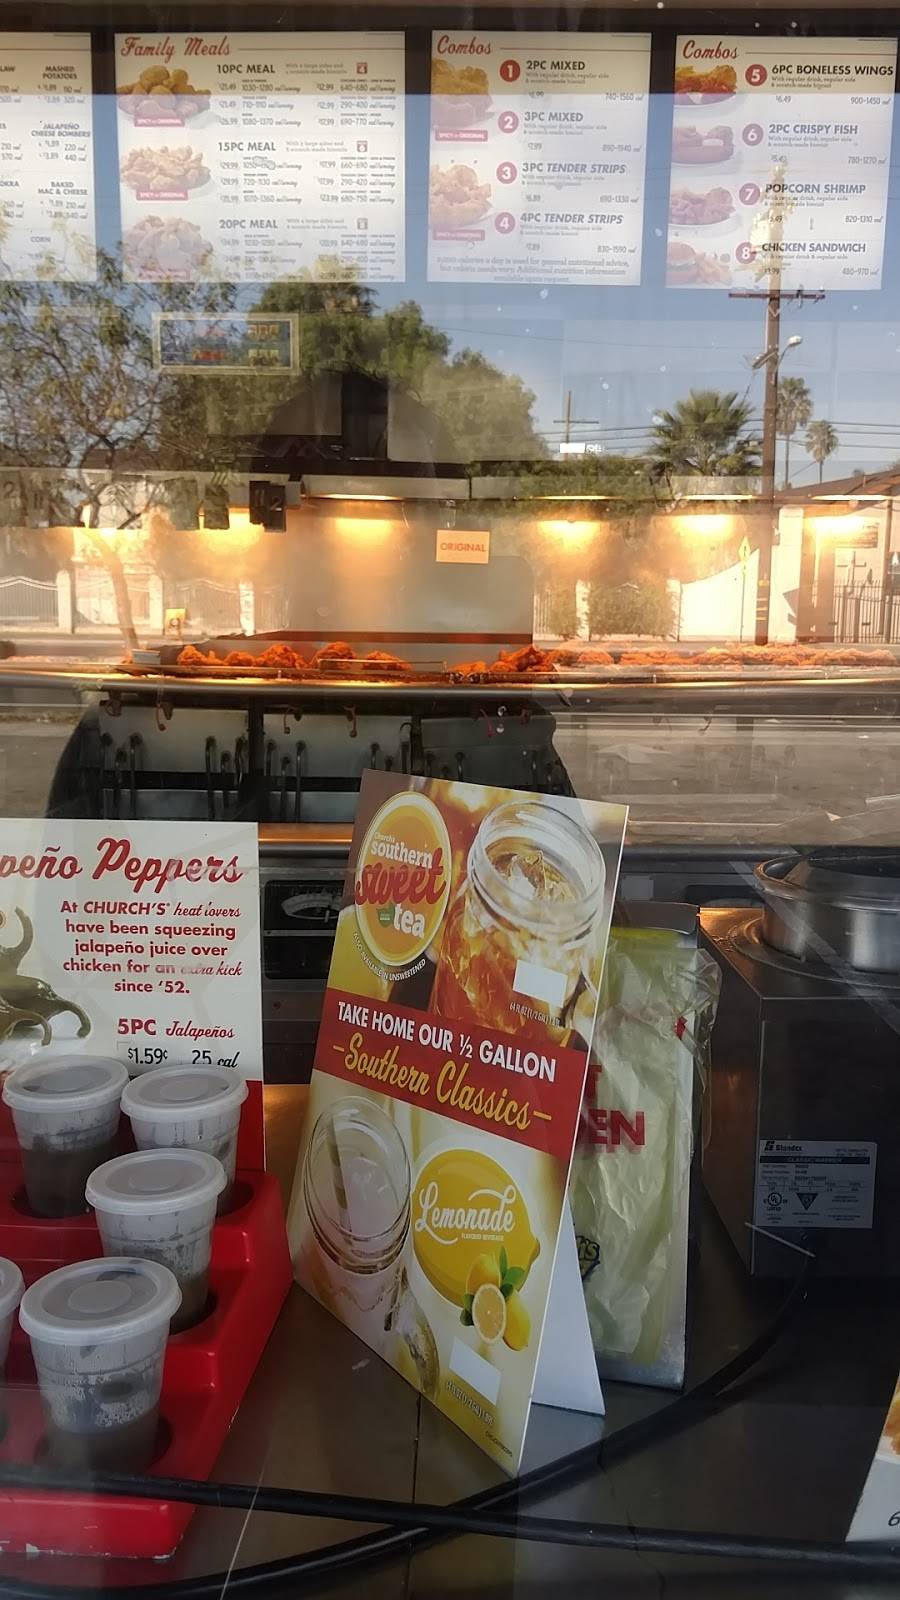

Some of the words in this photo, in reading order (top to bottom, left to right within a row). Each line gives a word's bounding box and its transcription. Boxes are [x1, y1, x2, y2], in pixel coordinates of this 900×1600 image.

[121, 35, 175, 63] Family
[184, 35, 232, 56] Meals
[437, 34, 492, 55] Combos
[683, 40, 739, 59] Combos
[217, 64, 243, 73] 10PC
[246, 64, 275, 73] MEAL
[507, 65, 513, 78] 1
[526, 60, 547, 70] 2PC
[550, 60, 586, 71] MIXED
[772, 65, 793, 74] 6PC
[797, 65, 851, 75] BONELESS
[855, 66, 894, 75] WINGS
[751, 69, 760, 81] 5
[504, 116, 513, 129] 2
[524, 112, 545, 121] 3PC
[548, 112, 584, 121] MIXED
[748, 128, 757, 141] 6
[769, 124, 790, 134] 2PC
[793, 124, 831, 134] CRISPY
[834, 125, 858, 134] FISH
[218, 142, 243, 151] 15PC
[247, 142, 276, 151] MEAL
[502, 166, 511, 180] 3
[522, 163, 544, 172] 3PC
[547, 163, 587, 173] TENDER
[590, 164, 627, 174] STRIPS
[744, 189, 753, 200] 7
[765, 184, 820, 193] POPCORN
[824, 184, 866, 194] SHRIMP
[219, 219, 246, 229] 20PC
[249, 219, 278, 229] MEAL
[501, 216, 510, 228] 4
[520, 213, 541, 222] 4PC
[544, 213, 585, 223] TENDER
[588, 214, 624, 224] STRIPS
[742, 247, 750, 258] 8
[762, 243, 806, 252] CHICKEN
[809, 243, 866, 252] SANDWICH
[440, 542, 487, 552] ORIGINAL
[370, 840, 433, 869] southern
[92, 838, 243, 893] Peppers
[355, 847, 447, 905] sweet
[60, 900, 78, 913] At
[173, 902, 202, 917] heat
[394, 903, 426, 939] tea
[65, 919, 104, 934] have
[110, 920, 149, 935] been
[155, 923, 236, 941] squeezing
[74, 939, 144, 957] jalapeño
[150, 941, 186, 957] juice
[191, 944, 228, 956] over
[63, 958, 121, 972] chicken
[127, 960, 150, 973] for
[155, 964, 175, 974] an
[215, 961, 242, 976] kick
[389, 958, 426, 982] UNSWEETENED
[114, 979, 153, 992] since
[117, 1019, 156, 1036] 5PC
[165, 1020, 236, 1041] Jalapeños
[338, 1001, 369, 1028] TAKE
[371, 1010, 416, 1042] HOME
[419, 1023, 454, 1053] OUR
[480, 1040, 556, 1083] GALLON
[192, 1050, 211, 1065] 25
[217, 1051, 240, 1068] cal
[415, 1181, 516, 1245] Lemonade
